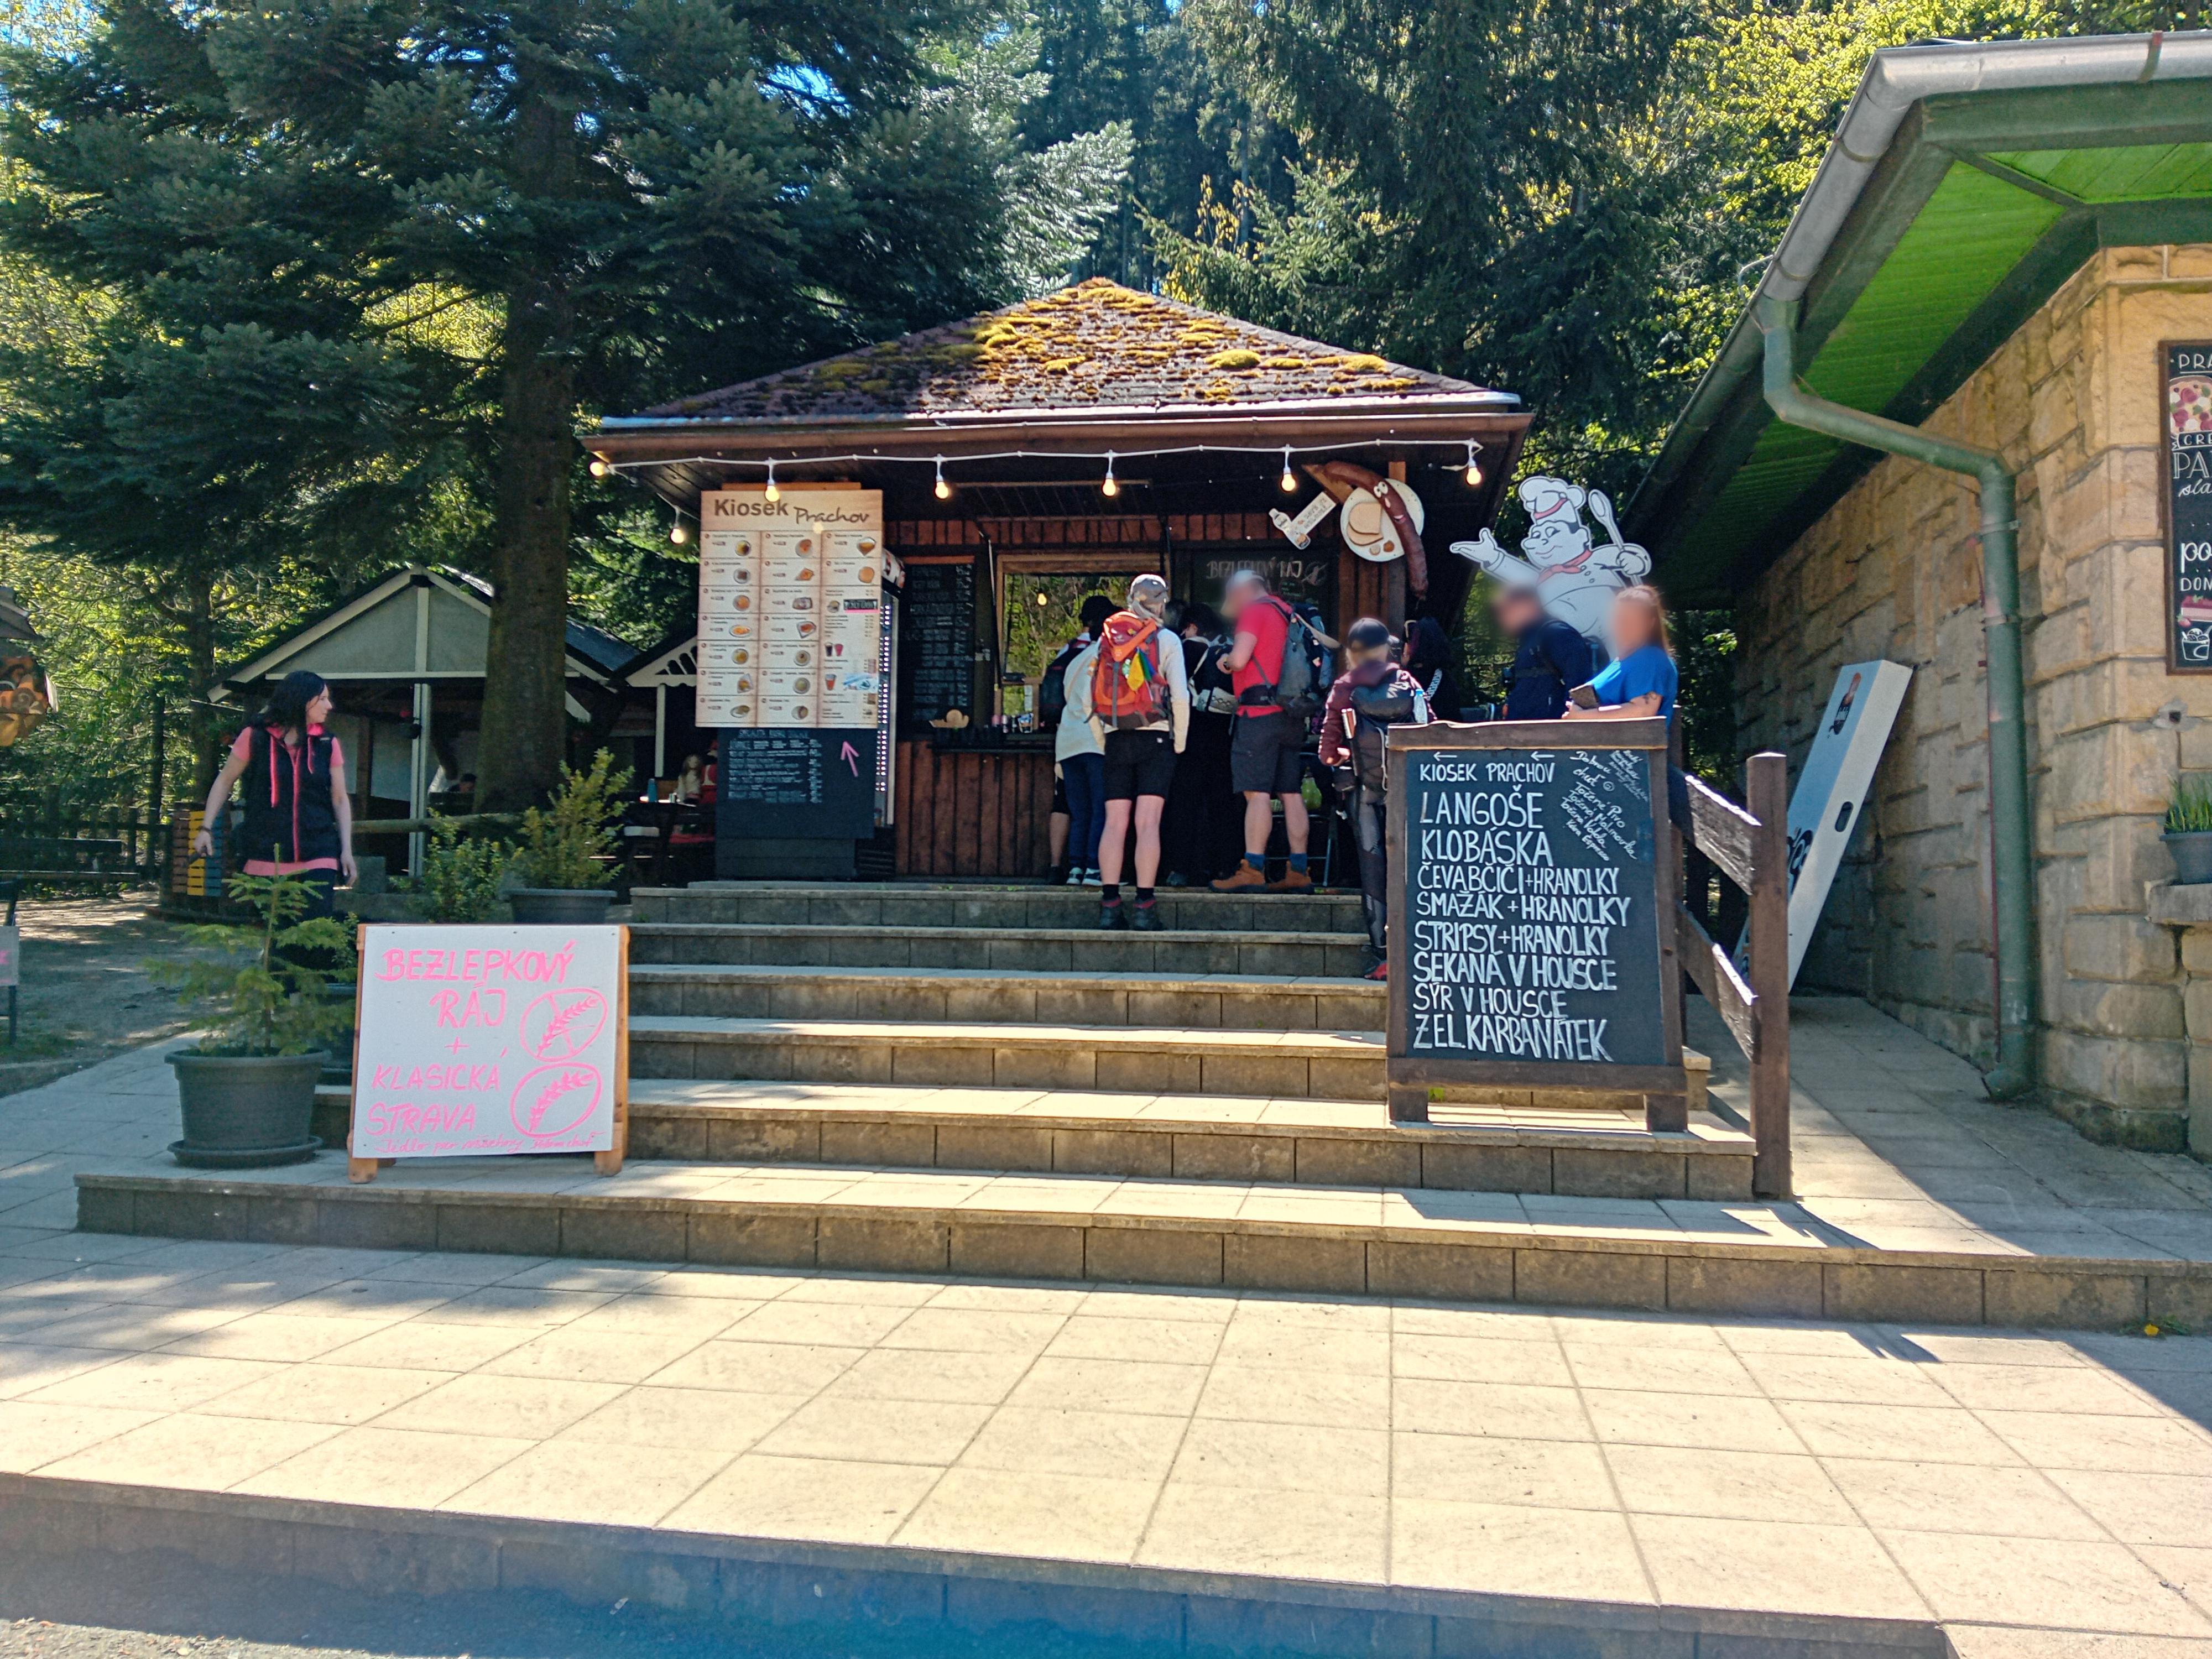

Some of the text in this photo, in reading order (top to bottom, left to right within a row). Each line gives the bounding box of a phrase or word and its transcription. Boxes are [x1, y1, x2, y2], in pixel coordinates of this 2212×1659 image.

[2173, 450, 2212, 479] PA
[714, 499, 869, 524] Kiosek Prachov
[1420, 762, 1555, 783] KIOSEK PRACHOV
[1569, 750, 1612, 774] Dobrou
[1420, 784, 1543, 828] LANGOŠE
[1574, 781, 1625, 828] Točené Pivo
[1421, 826, 1554, 867] KLOBÁSKA
[1416, 890, 1631, 927] SMAŽÁK + HRANOLKY
[374, 940, 577, 983] BEZLEPKOVÝ
[1412, 950, 1618, 991] SEKANÁ V HOUSCE
[429, 982, 507, 1029] RÁJ
[1412, 982, 1569, 1019] SÝR V HOUSCE
[445, 1036, 469, 1055] +
[1465, 1014, 1615, 1062] KARBANÁTEK
[371, 1047, 507, 1092] KLASICKÁ
[363, 1102, 477, 1136] STRAVA
